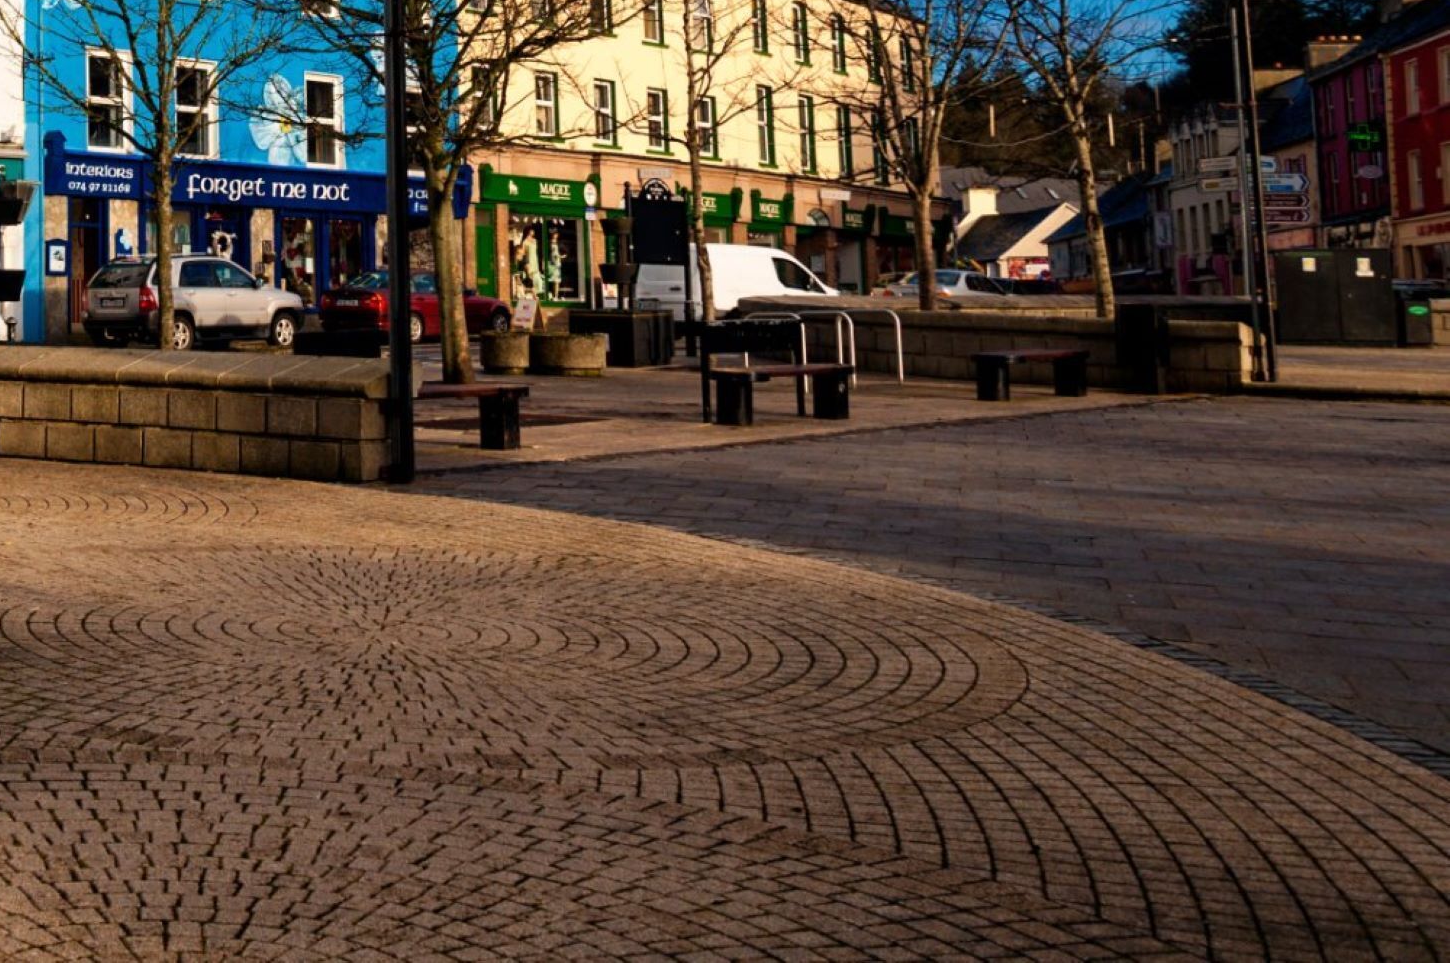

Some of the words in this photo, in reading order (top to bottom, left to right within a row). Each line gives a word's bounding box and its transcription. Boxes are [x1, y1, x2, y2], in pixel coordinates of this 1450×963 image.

[68, 180, 86, 193] 074
[88, 182, 100, 193] 97
[271, 181, 307, 199] me
[312, 183, 350, 201] not
[540, 182, 571, 196] MAGEE
